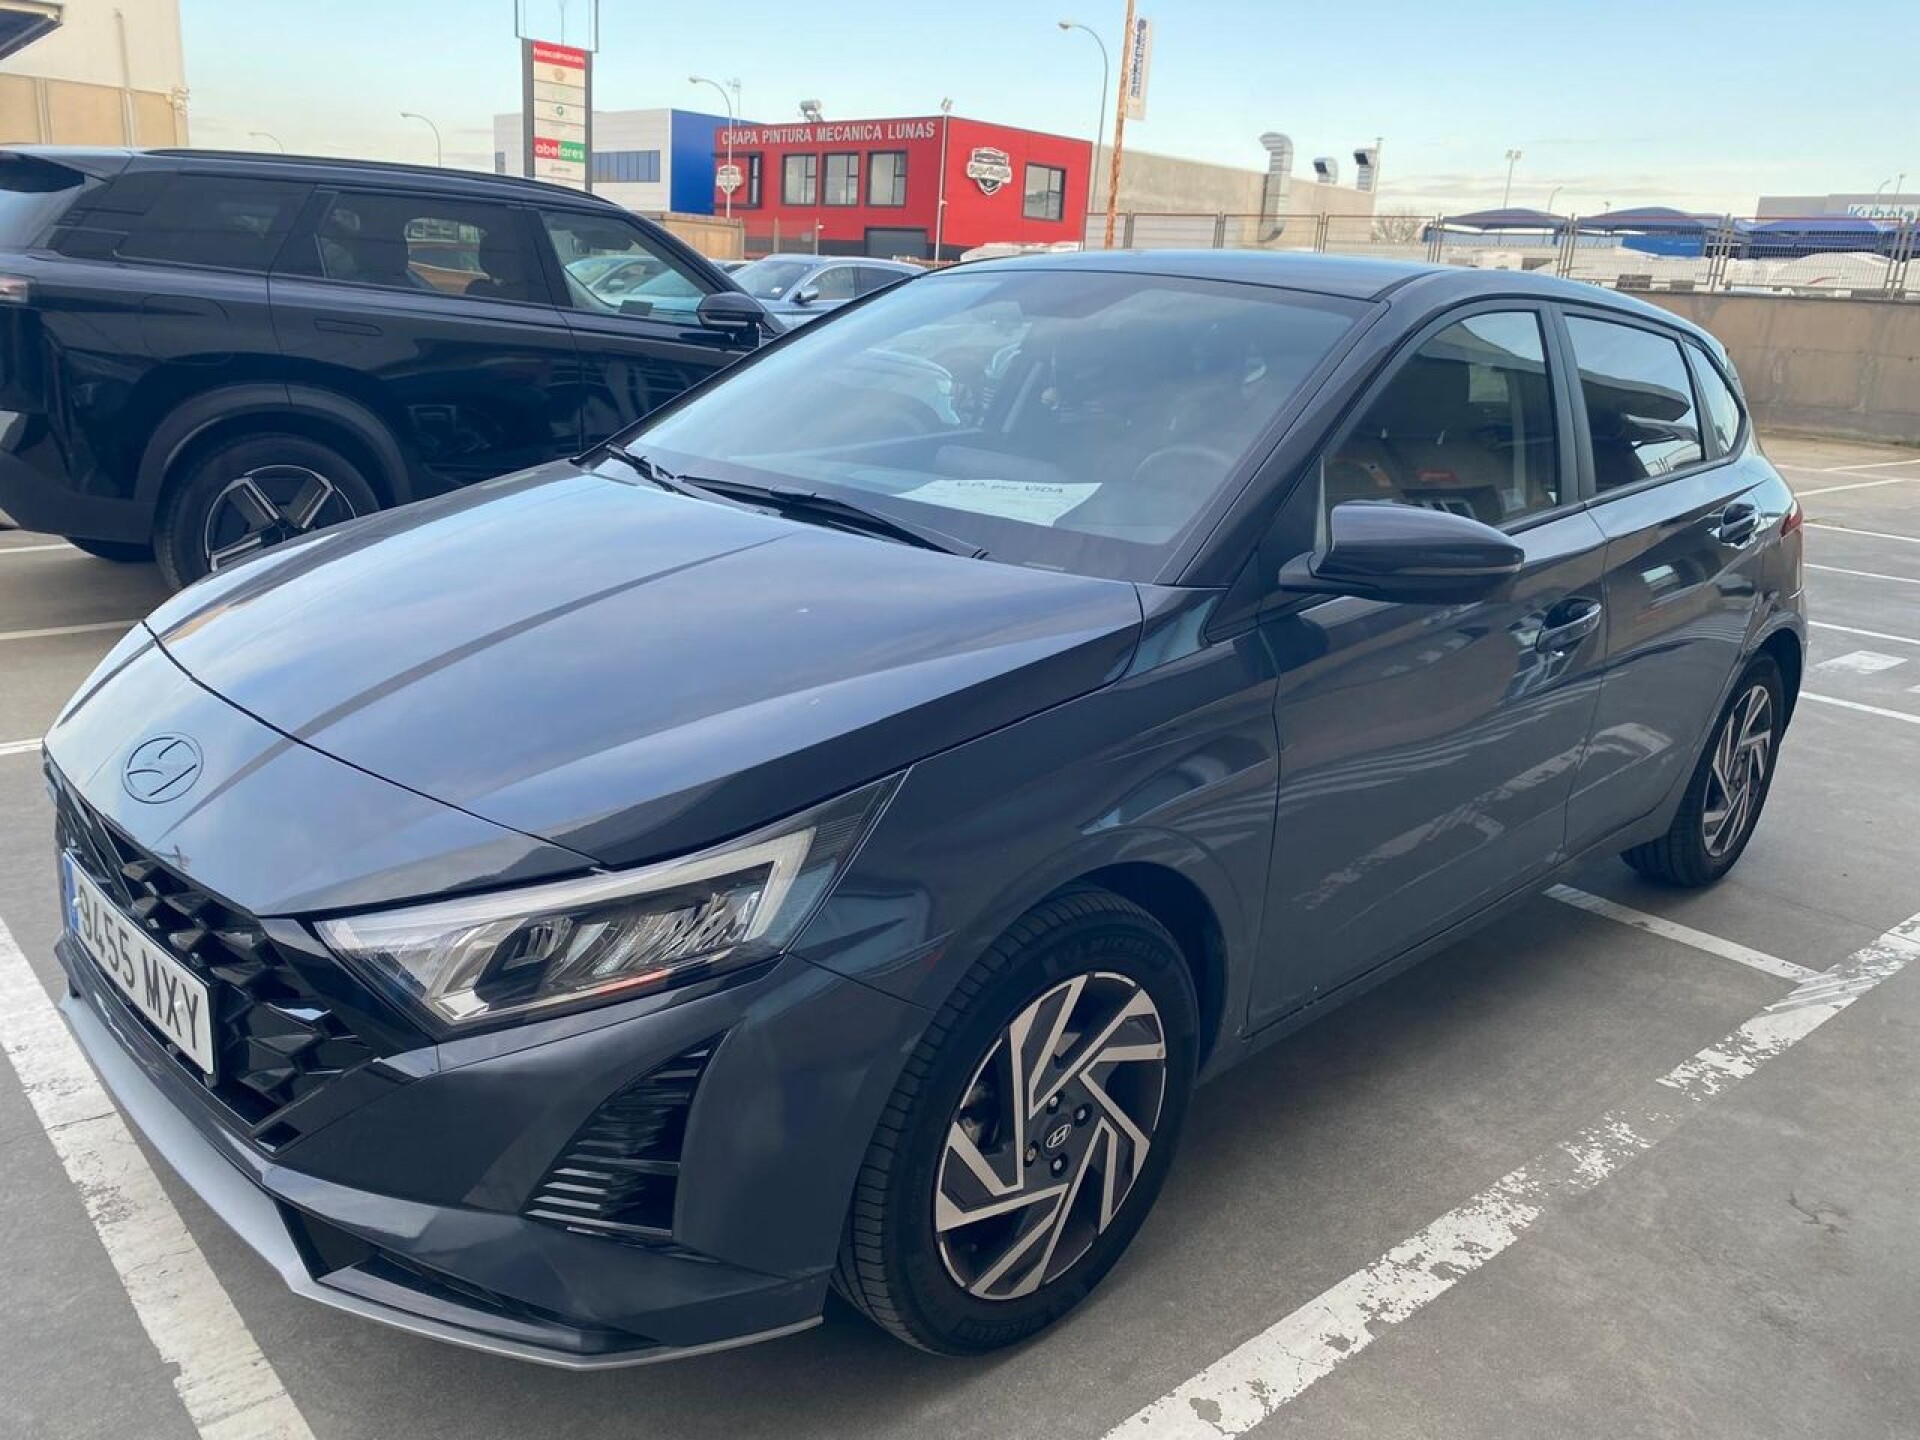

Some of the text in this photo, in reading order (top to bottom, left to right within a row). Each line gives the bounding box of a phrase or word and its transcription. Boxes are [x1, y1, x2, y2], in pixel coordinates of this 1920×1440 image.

[722, 121, 935, 145] CHAPA PINTURA MECANICA LUNAS
[79, 885, 198, 1050] 9455 MXY
